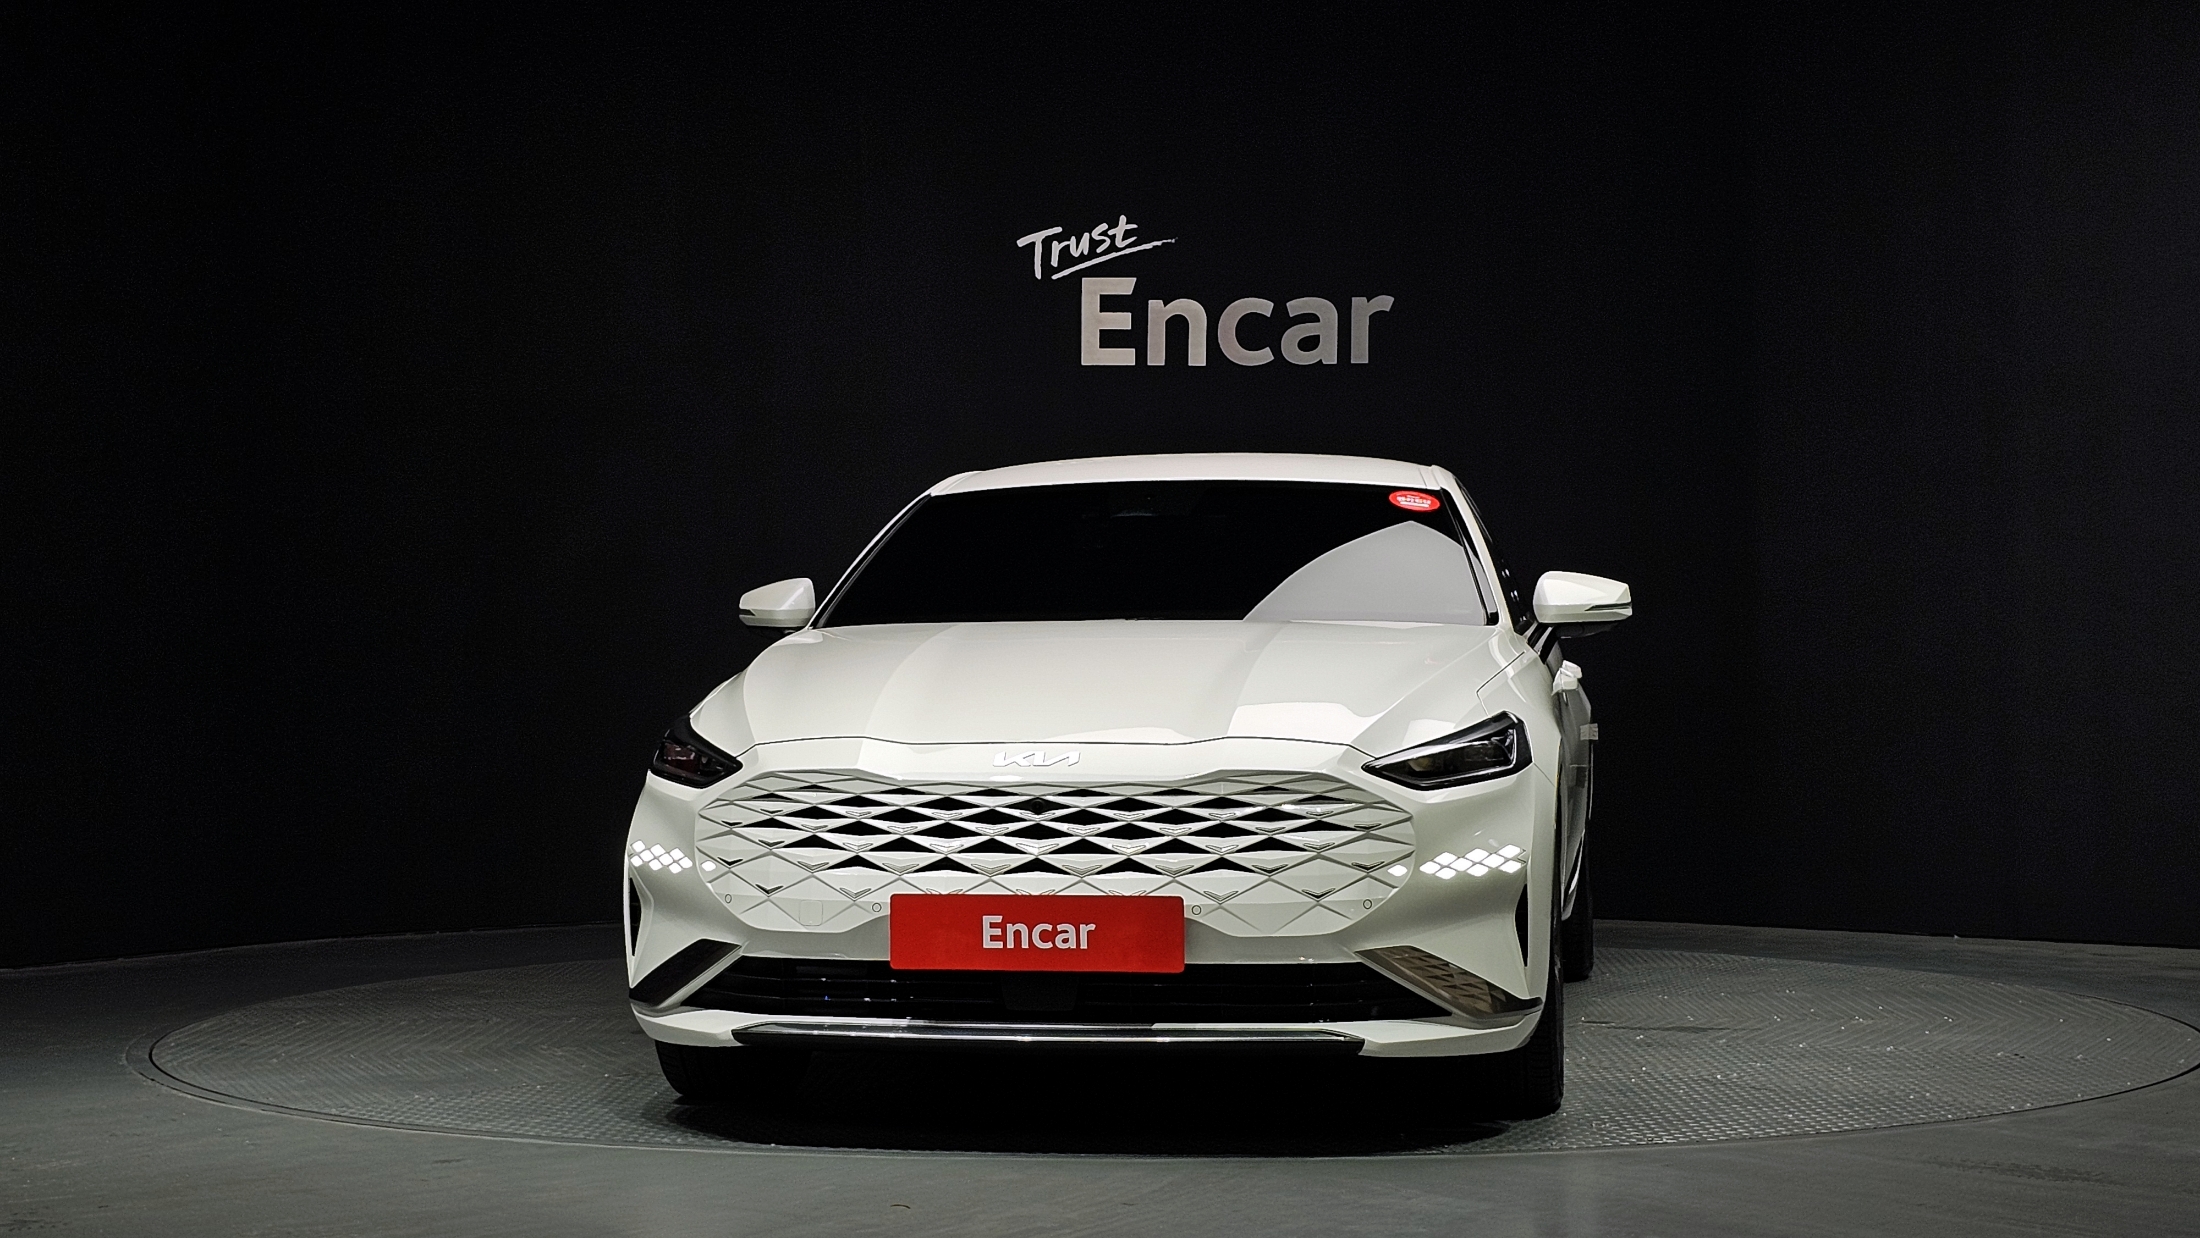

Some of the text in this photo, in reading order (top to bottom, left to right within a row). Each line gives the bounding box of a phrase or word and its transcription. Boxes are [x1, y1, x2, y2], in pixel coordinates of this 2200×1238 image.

[1017, 214, 1139, 279] Trust
[1081, 277, 1395, 366] Encar
[993, 751, 1080, 767] KIA
[982, 915, 1096, 949] Encar
